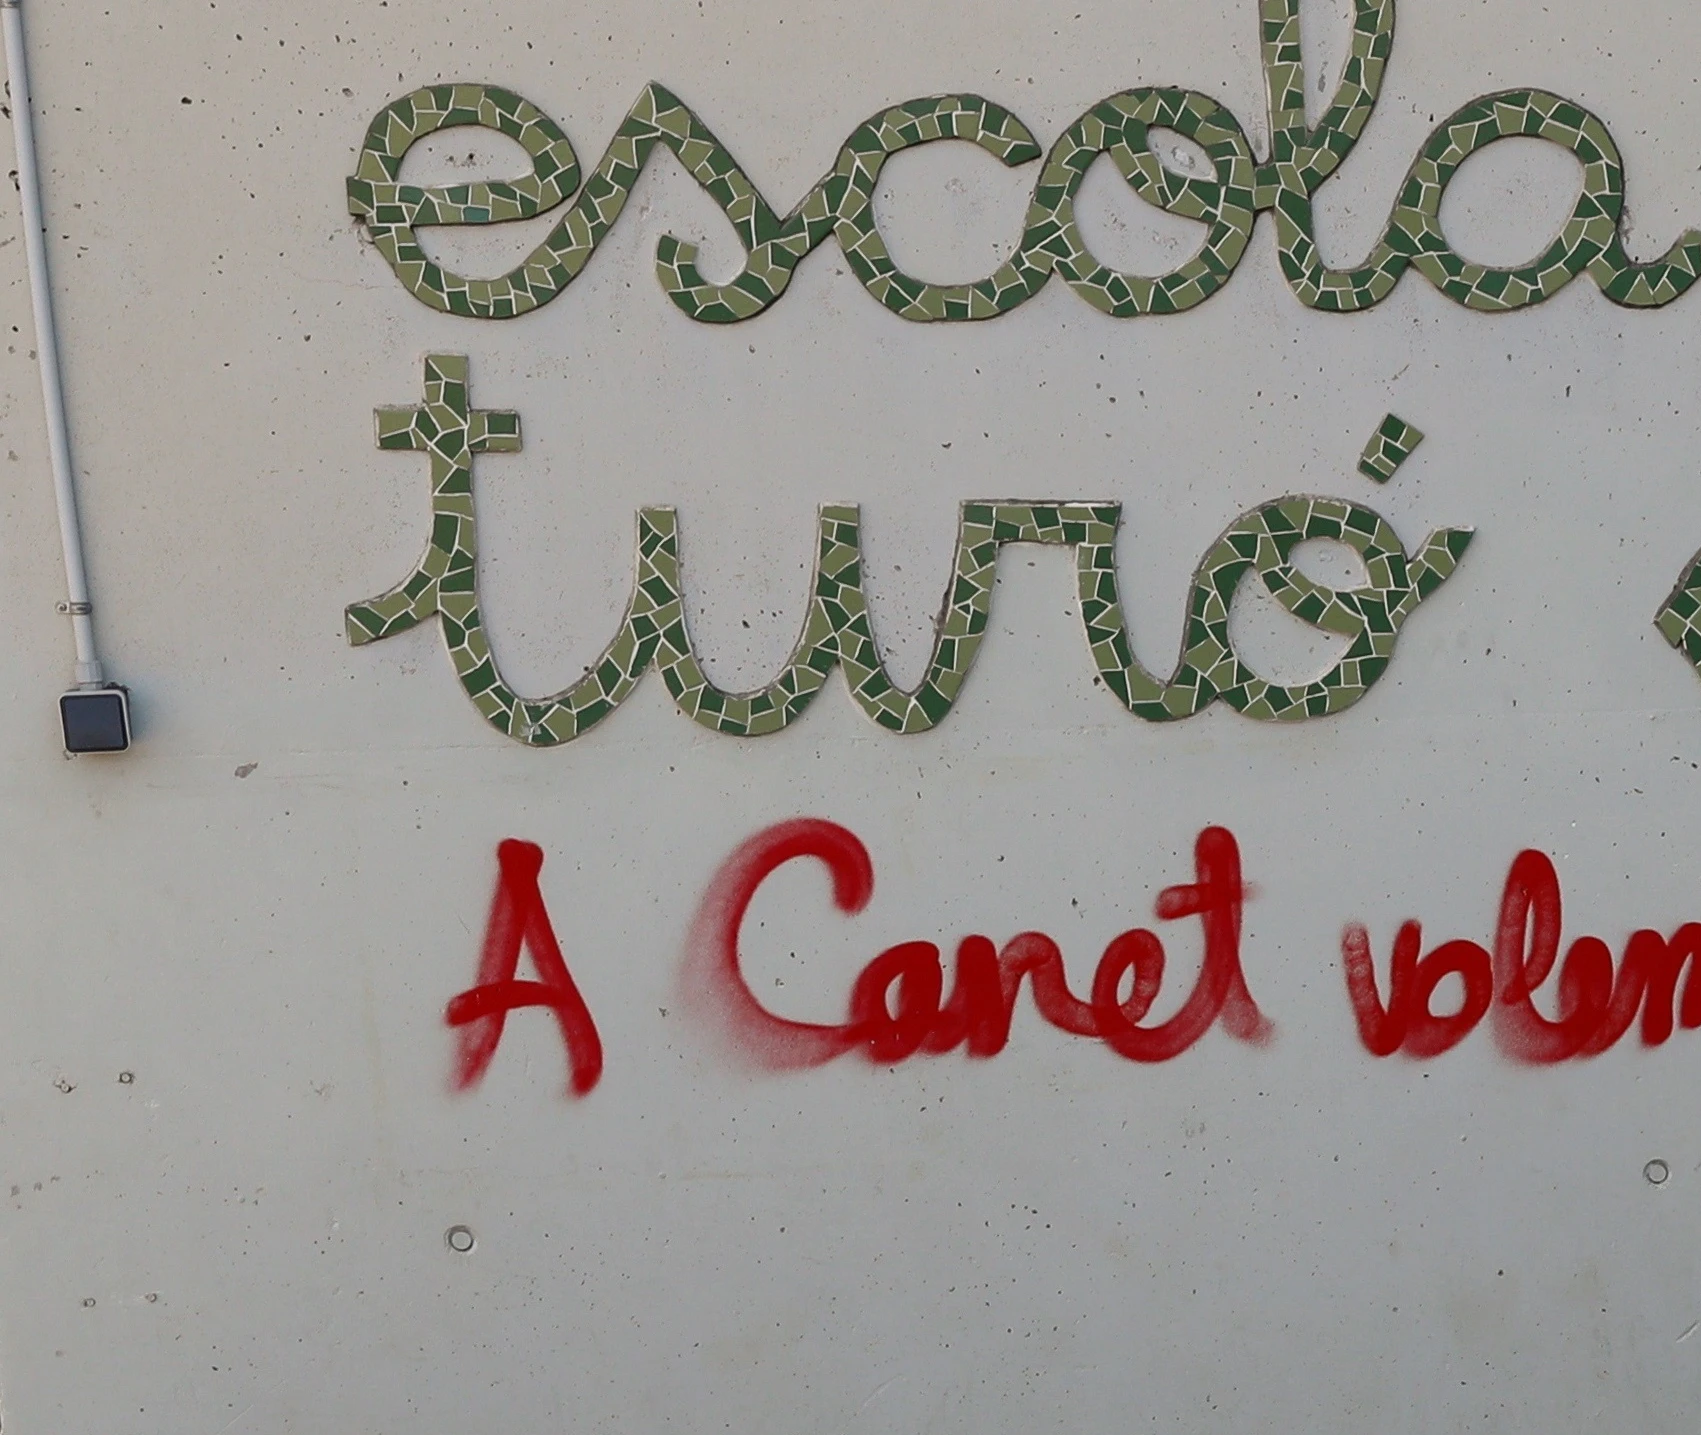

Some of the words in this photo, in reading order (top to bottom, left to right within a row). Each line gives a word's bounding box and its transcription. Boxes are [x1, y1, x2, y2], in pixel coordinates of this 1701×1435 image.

[345, 352, 1475, 746] turó
[444, 836, 604, 1097] A
[690, 816, 1270, 1068] Canet
